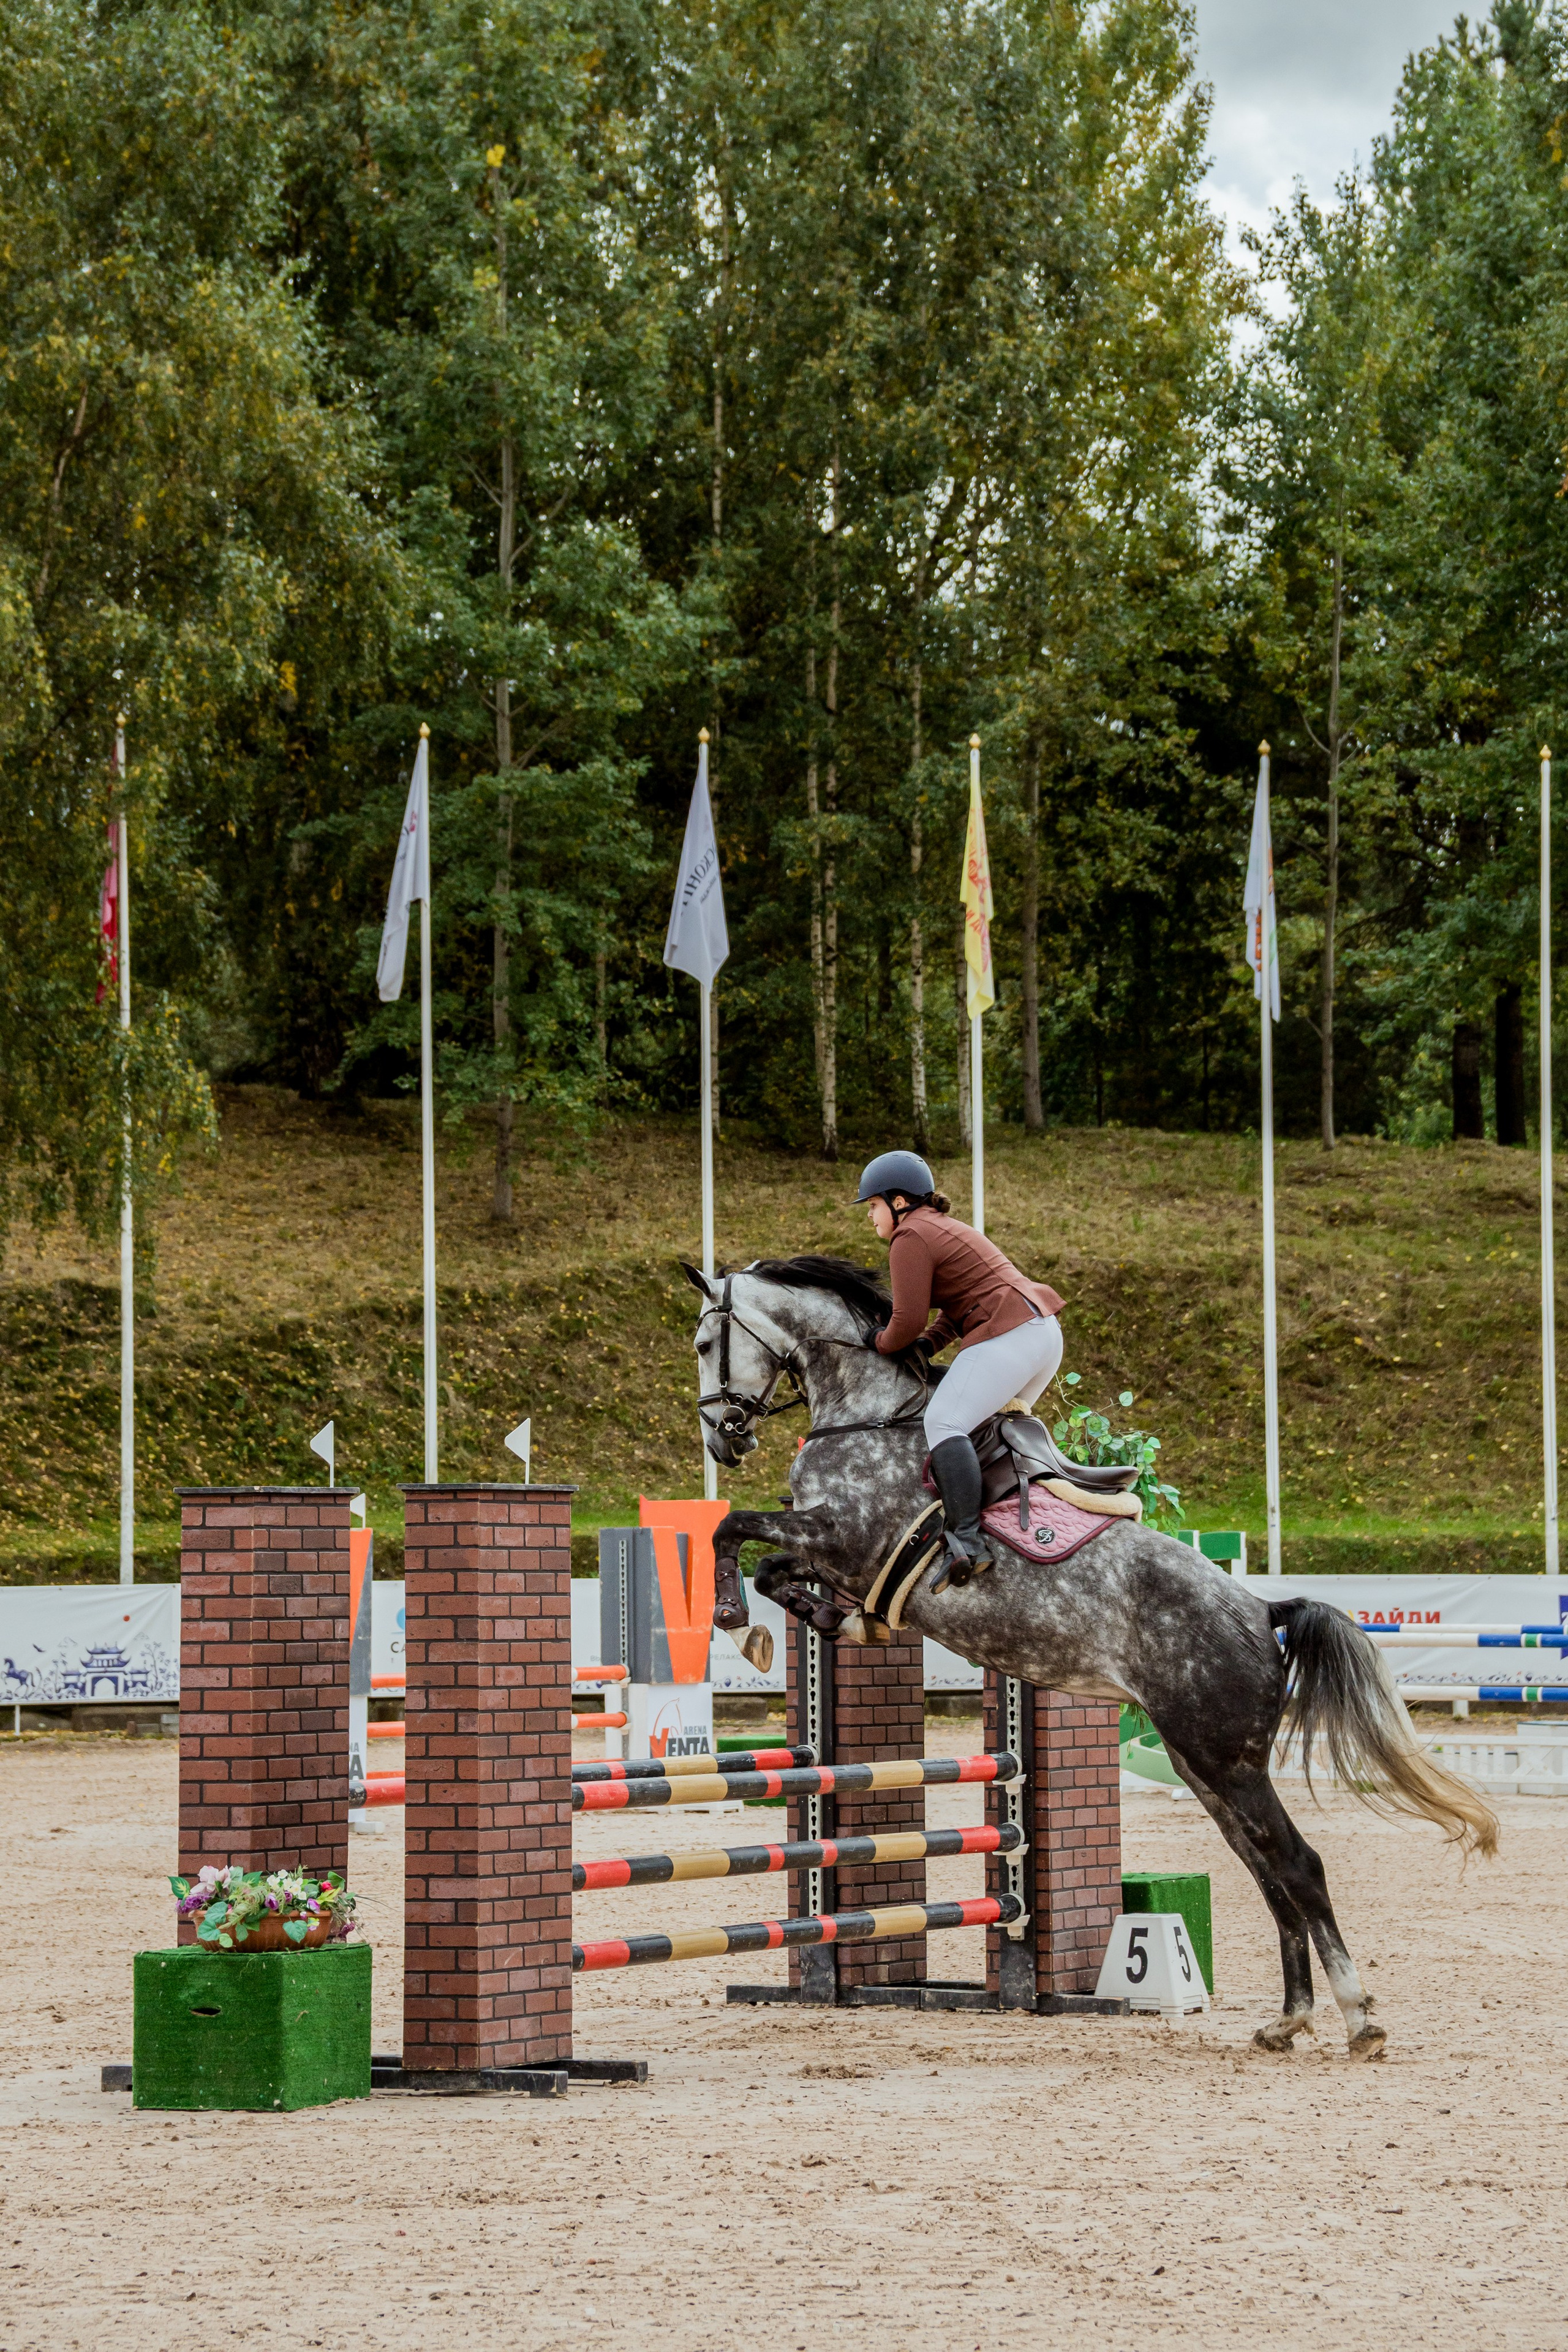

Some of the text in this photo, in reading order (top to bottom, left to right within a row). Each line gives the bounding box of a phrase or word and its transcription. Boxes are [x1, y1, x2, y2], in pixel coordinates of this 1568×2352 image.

[649, 1727, 710, 1759] VENTA
[684, 1725, 707, 1735] ARENA
[1126, 1927, 1148, 1984] 5
[1174, 1926, 1191, 1983] 5
